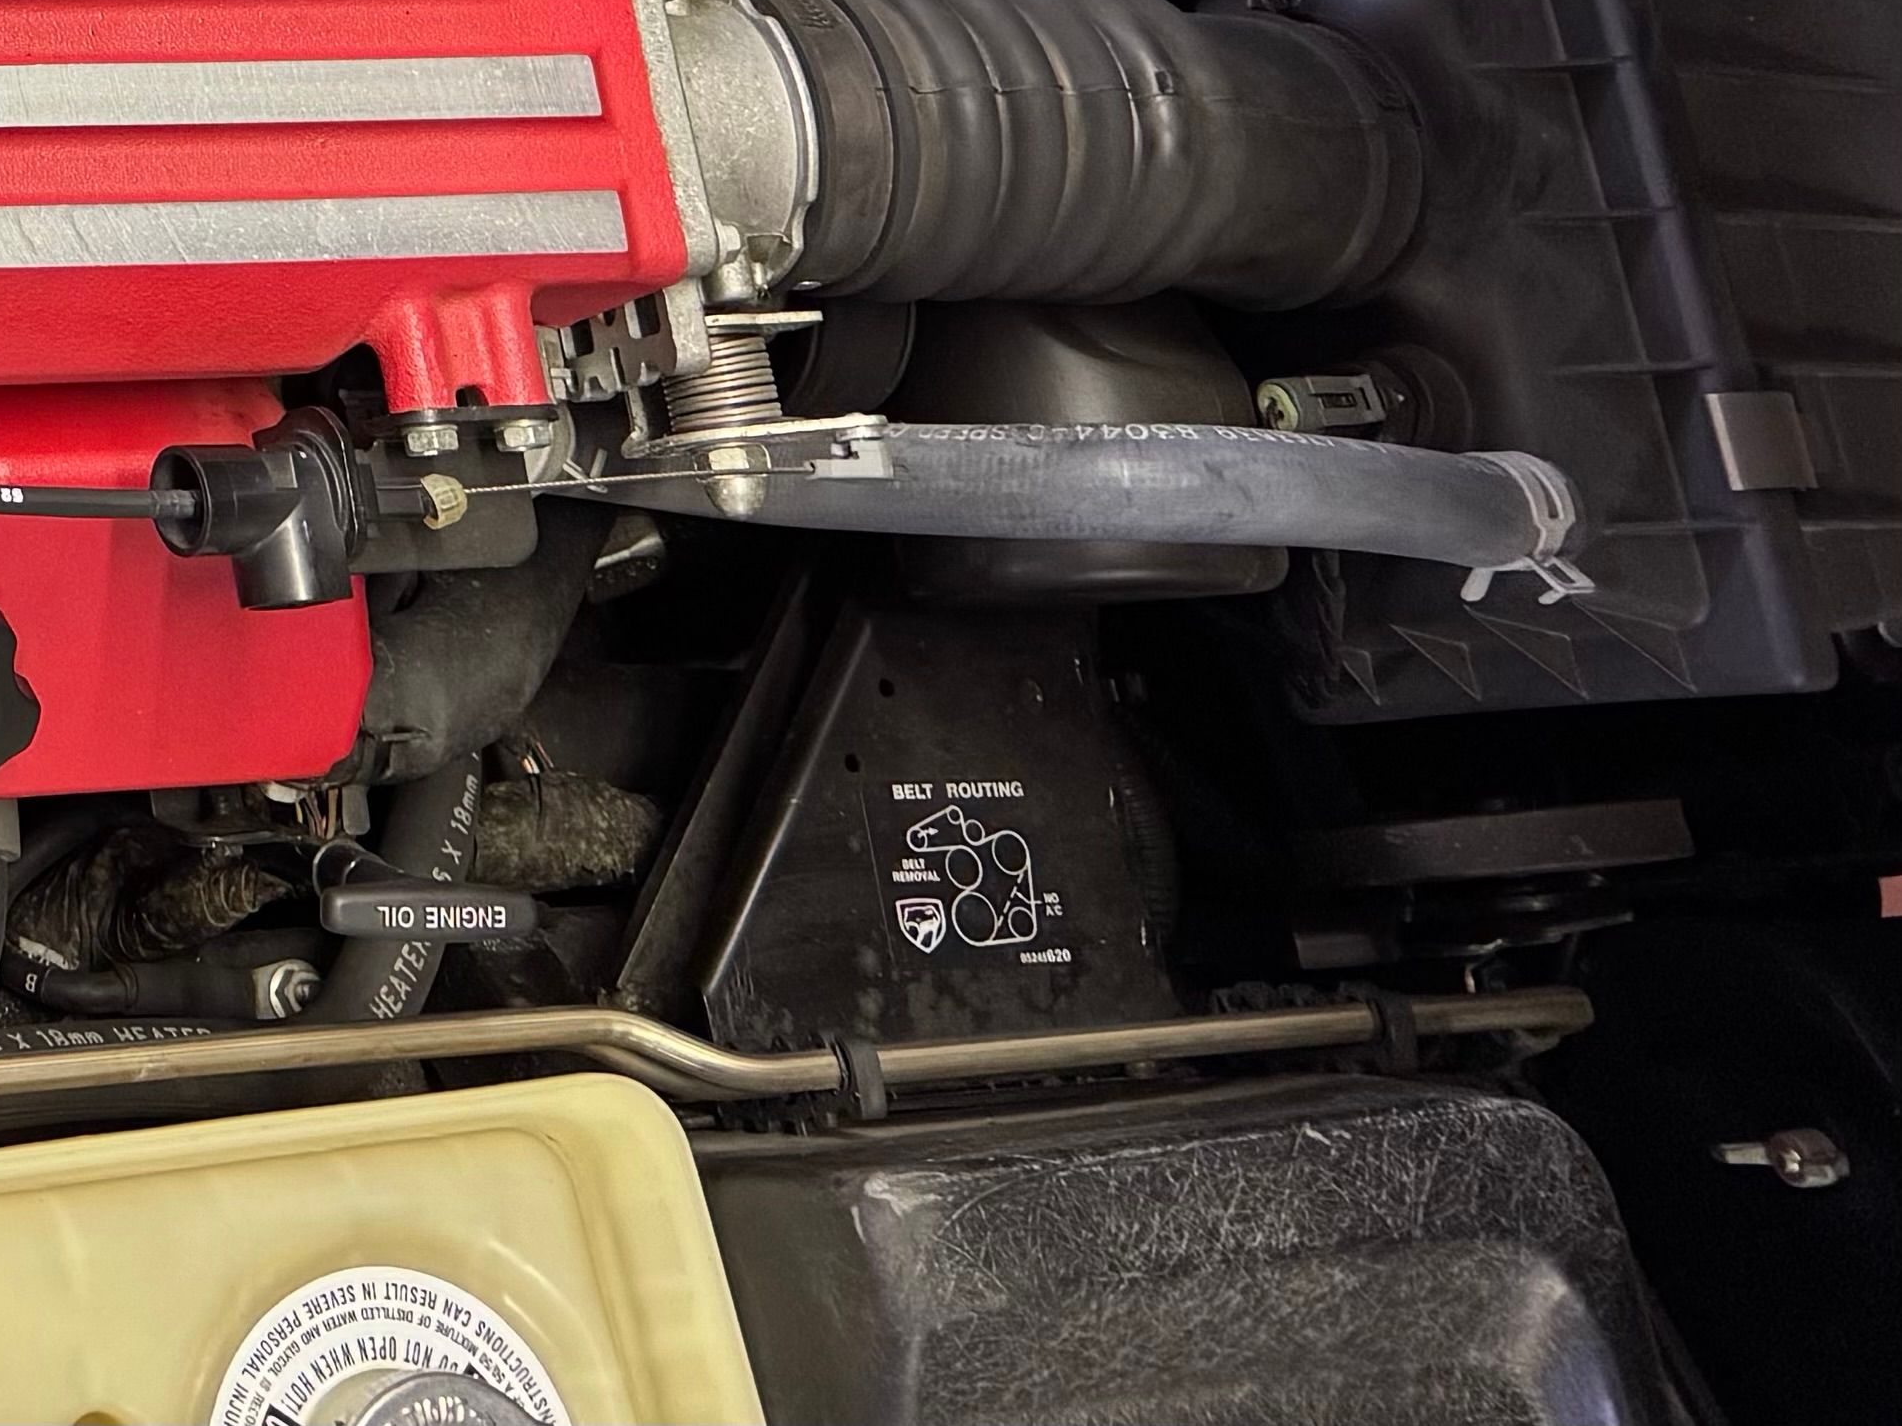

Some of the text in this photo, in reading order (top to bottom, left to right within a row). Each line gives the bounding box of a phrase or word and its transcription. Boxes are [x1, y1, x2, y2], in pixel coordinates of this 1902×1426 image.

[891, 780, 1025, 801] BELT ROUTING
[891, 869, 941, 883] REMOVAL
[901, 858, 926, 870] BELT
[376, 905, 507, 929] ENGINE OIL
[36, 1028, 105, 1047] 18mm
[302, 1284, 356, 1321] SEVERE
[361, 1281, 377, 1301] IN
[383, 1281, 438, 1310] RESULT
[322, 1309, 358, 1333] WATER
[360, 1305, 414, 1324] DISTILLED
[417, 1313, 432, 1329] OF
[443, 1298, 472, 1328] CAN
[241, 1309, 302, 1380] PERSONAL
[300, 1323, 322, 1345] AND
[434, 1319, 479, 1357] MIXTURE
[267, 1340, 301, 1378] GLYCOL
[309, 1341, 356, 1384] WHEN
[356, 1335, 397, 1363] OPEN
[403, 1338, 434, 1369] NOT
[474, 1320, 557, 1425] NSTRUCTIONS
[281, 1370, 316, 1416] HOT!
